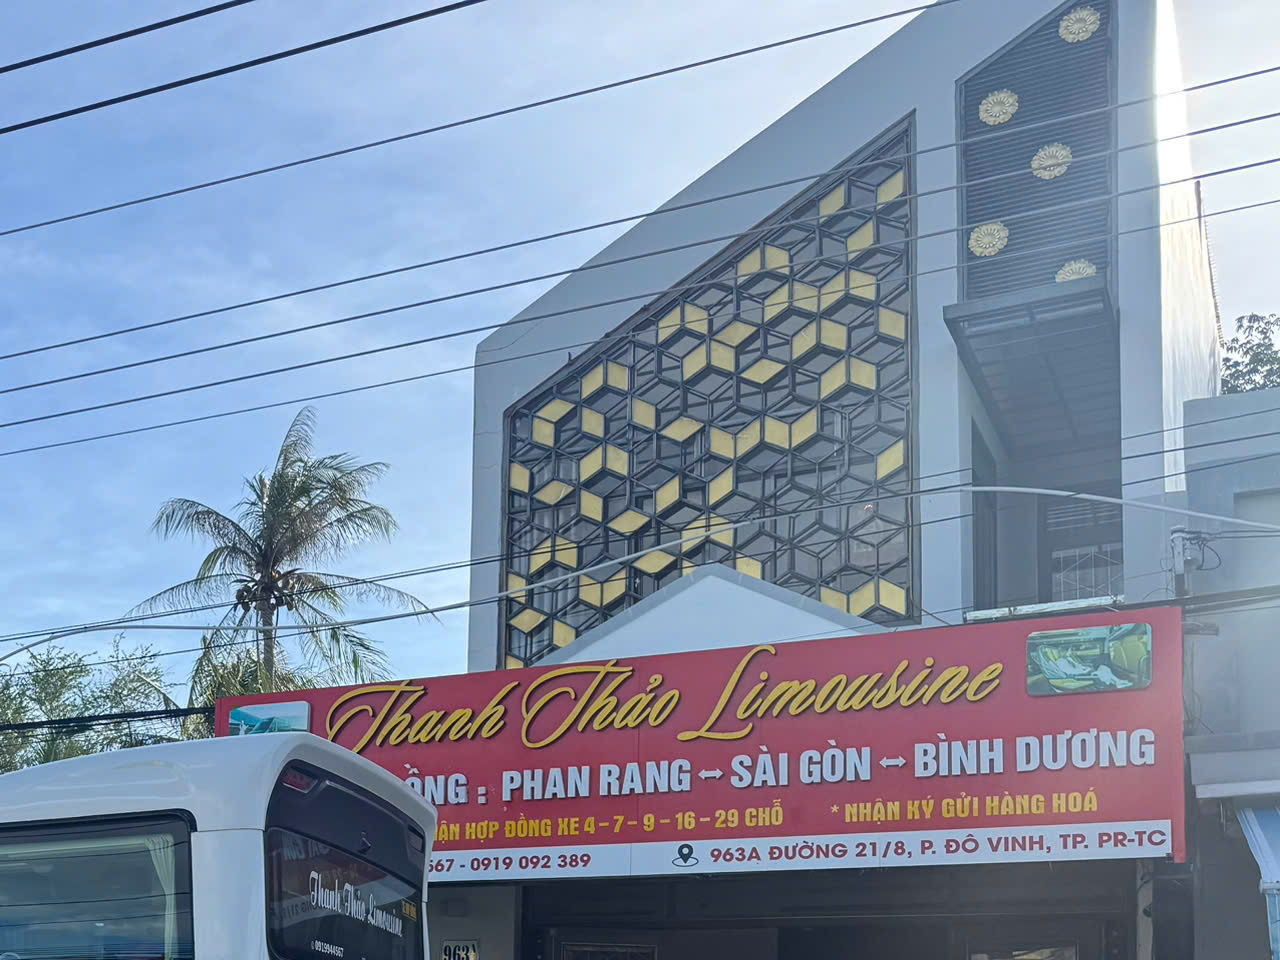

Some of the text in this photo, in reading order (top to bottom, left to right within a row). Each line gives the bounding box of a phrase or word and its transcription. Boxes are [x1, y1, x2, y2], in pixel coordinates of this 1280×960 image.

[325, 645, 1004, 752] Thanh Thảo Limousine
[502, 765, 591, 802] PHAN
[599, 758, 692, 796] RANG
[730, 744, 789, 789] SÀI
[799, 738, 871, 785] GÒN
[914, 733, 1004, 778] BÌNH
[1016, 728, 1156, 772] DƯƠNG
[435, 820, 461, 844] ẬN
[465, 819, 500, 843] HỢP
[504, 812, 552, 838] ĐỒNG
[557, 816, 580, 837] XE
[744, 799, 784, 827] CHỖ
[844, 787, 1098, 824] NHẬN KÝ GỬI HÀNG HOÁ
[470, 856, 513, 872] 0919
[519, 854, 552, 870] 092
[557, 853, 592, 868] 389
[710, 829, 1167, 864] 963A ĐƯỜNG 21/8, P. ĐÔ VINH, TP. PR-TC
[309, 870, 342, 913] Thanh
